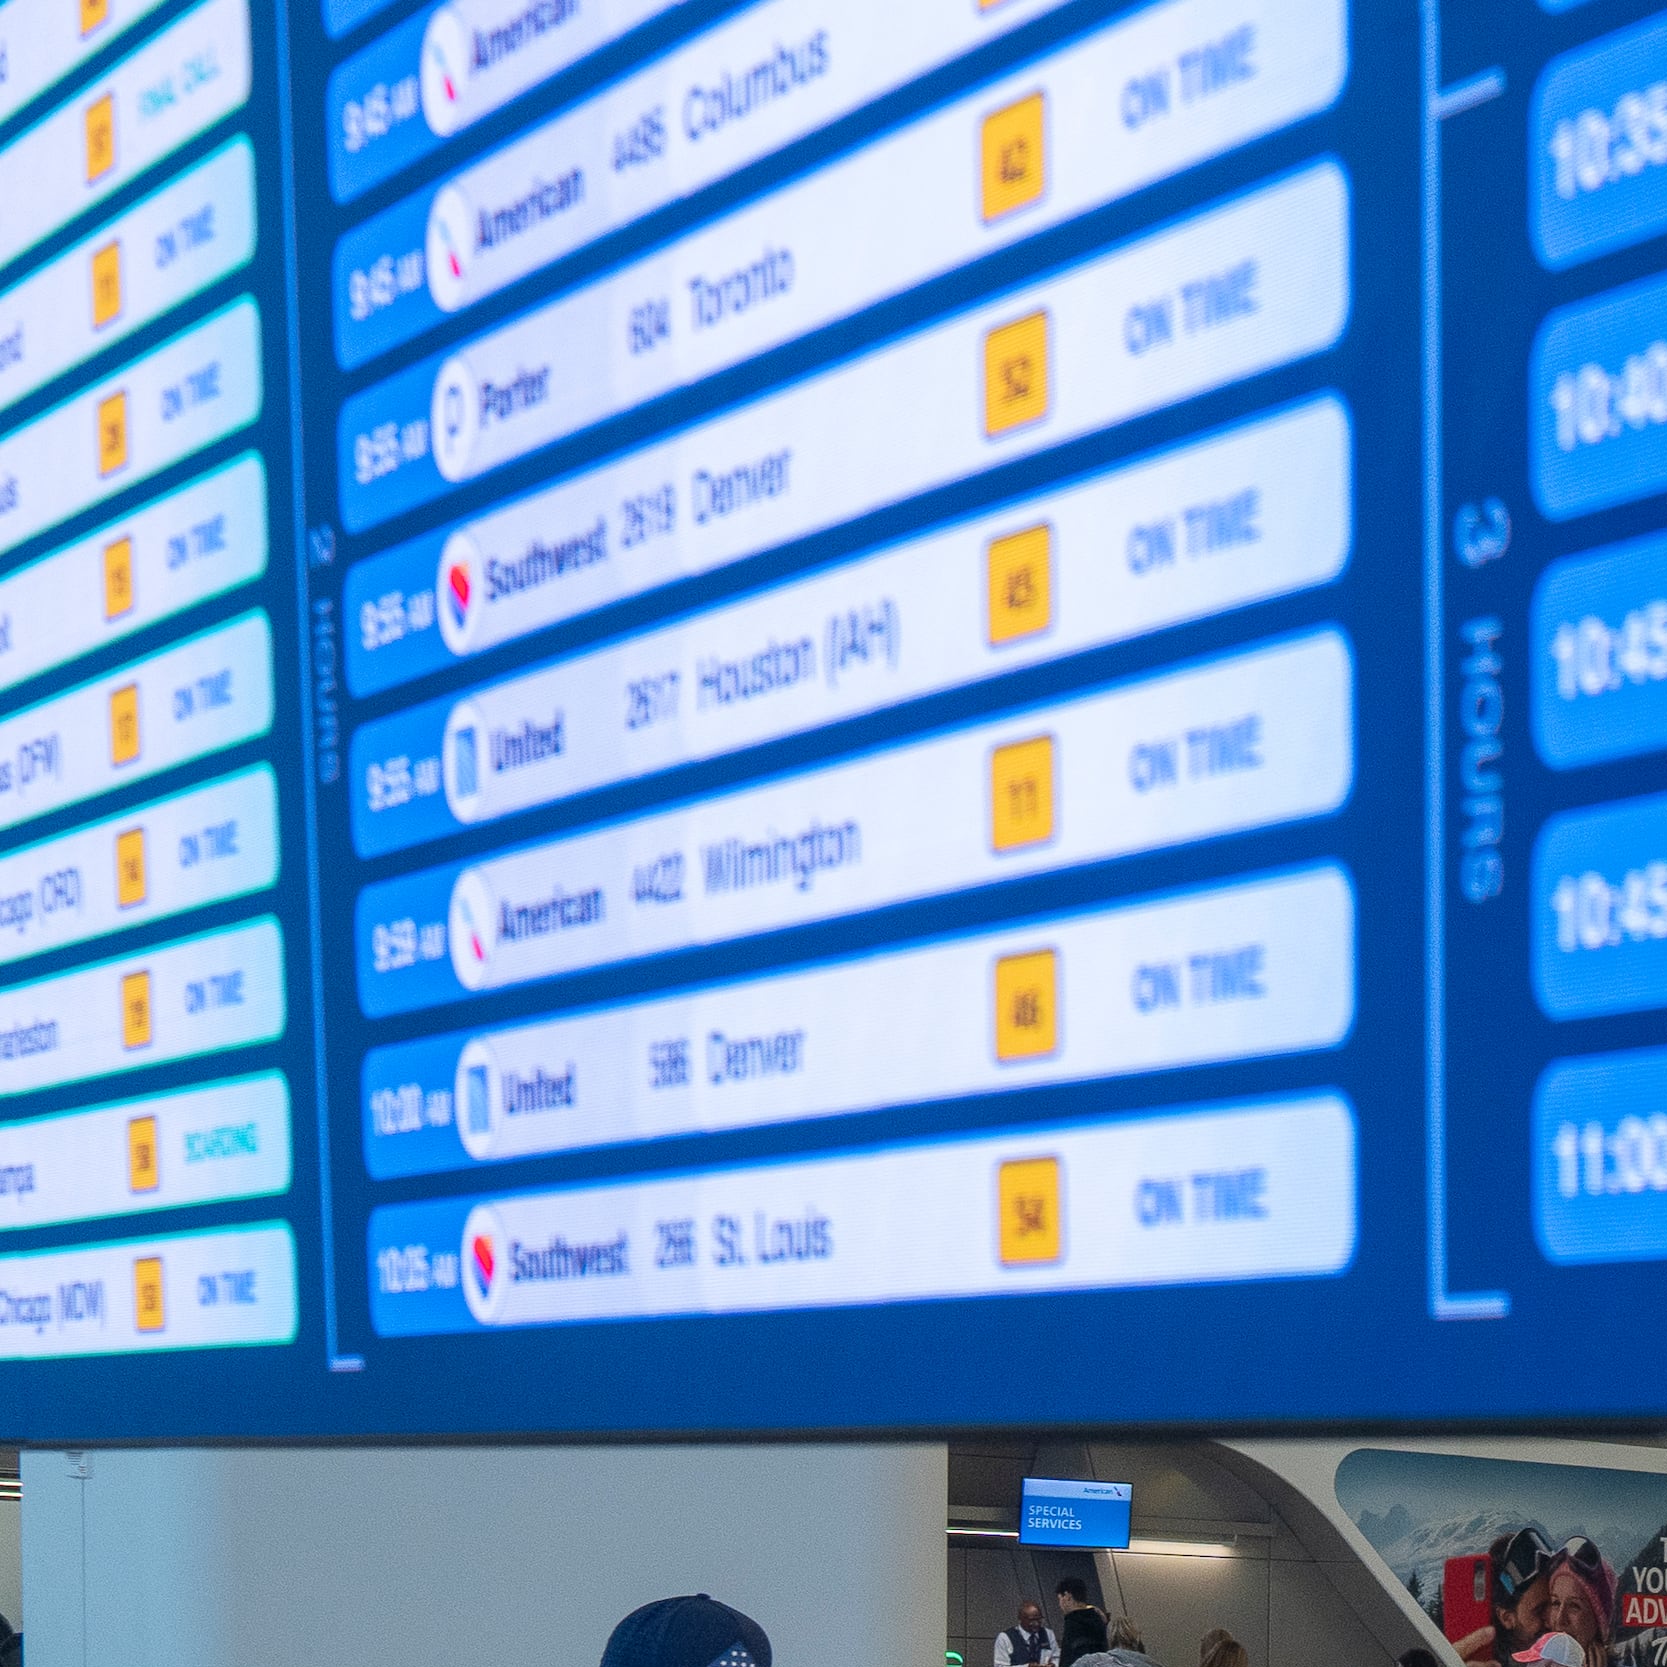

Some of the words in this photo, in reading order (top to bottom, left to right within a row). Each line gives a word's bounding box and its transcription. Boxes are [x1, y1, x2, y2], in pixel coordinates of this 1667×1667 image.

[475, 167, 586, 252] American
[682, 29, 831, 143] Columbus
[479, 363, 551, 428] Porter
[686, 247, 795, 333] Toronto
[1121, 67, 1171, 133] ON
[1177, 20, 1258, 108] TIME
[485, 513, 610, 602] Southwest
[691, 448, 791, 527] Denver
[1122, 295, 1175, 358] ON
[1179, 257, 1260, 334] TIME
[490, 708, 565, 772] United
[695, 636, 817, 712] Houston
[1126, 518, 1176, 578] ON
[1183, 485, 1263, 558] TIME
[1455, 496, 1511, 568] 3
[498, 882, 606, 943] American
[702, 817, 861, 892] Wilmington
[1128, 740, 1178, 795] ON
[1185, 711, 1265, 781] TIME
[1460, 615, 1505, 904] HOURS
[501, 1060, 576, 1114] United
[707, 1028, 805, 1087] Denver
[1132, 961, 1181, 1015] ON
[1189, 942, 1267, 1007] TIME
[508, 1232, 630, 1284] Southwest
[753, 1206, 833, 1265] Louis
[1134, 1176, 1185, 1228] ON
[1191, 1166, 1269, 1222] TIME
[1028, 1505, 1075, 1517] SPECIAL
[1028, 1518, 1082, 1530] SERVICES
[1083, 1487, 1113, 1495] American
